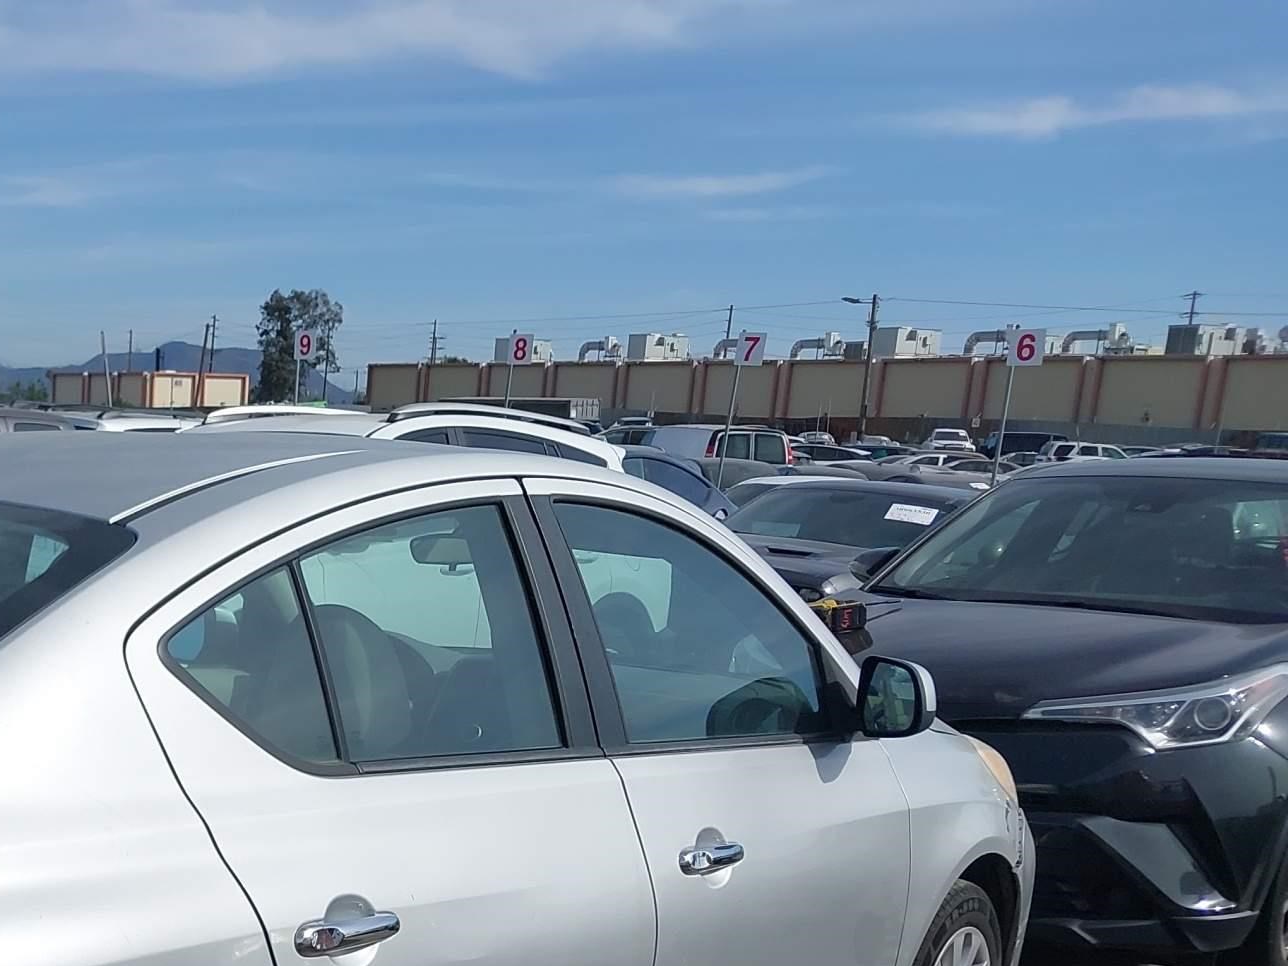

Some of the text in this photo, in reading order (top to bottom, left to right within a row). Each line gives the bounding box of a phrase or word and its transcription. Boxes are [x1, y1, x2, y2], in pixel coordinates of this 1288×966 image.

[300, 334, 311, 356] 9
[513, 337, 527, 361] 8
[743, 336, 761, 362] 7
[1016, 333, 1036, 362] 6
